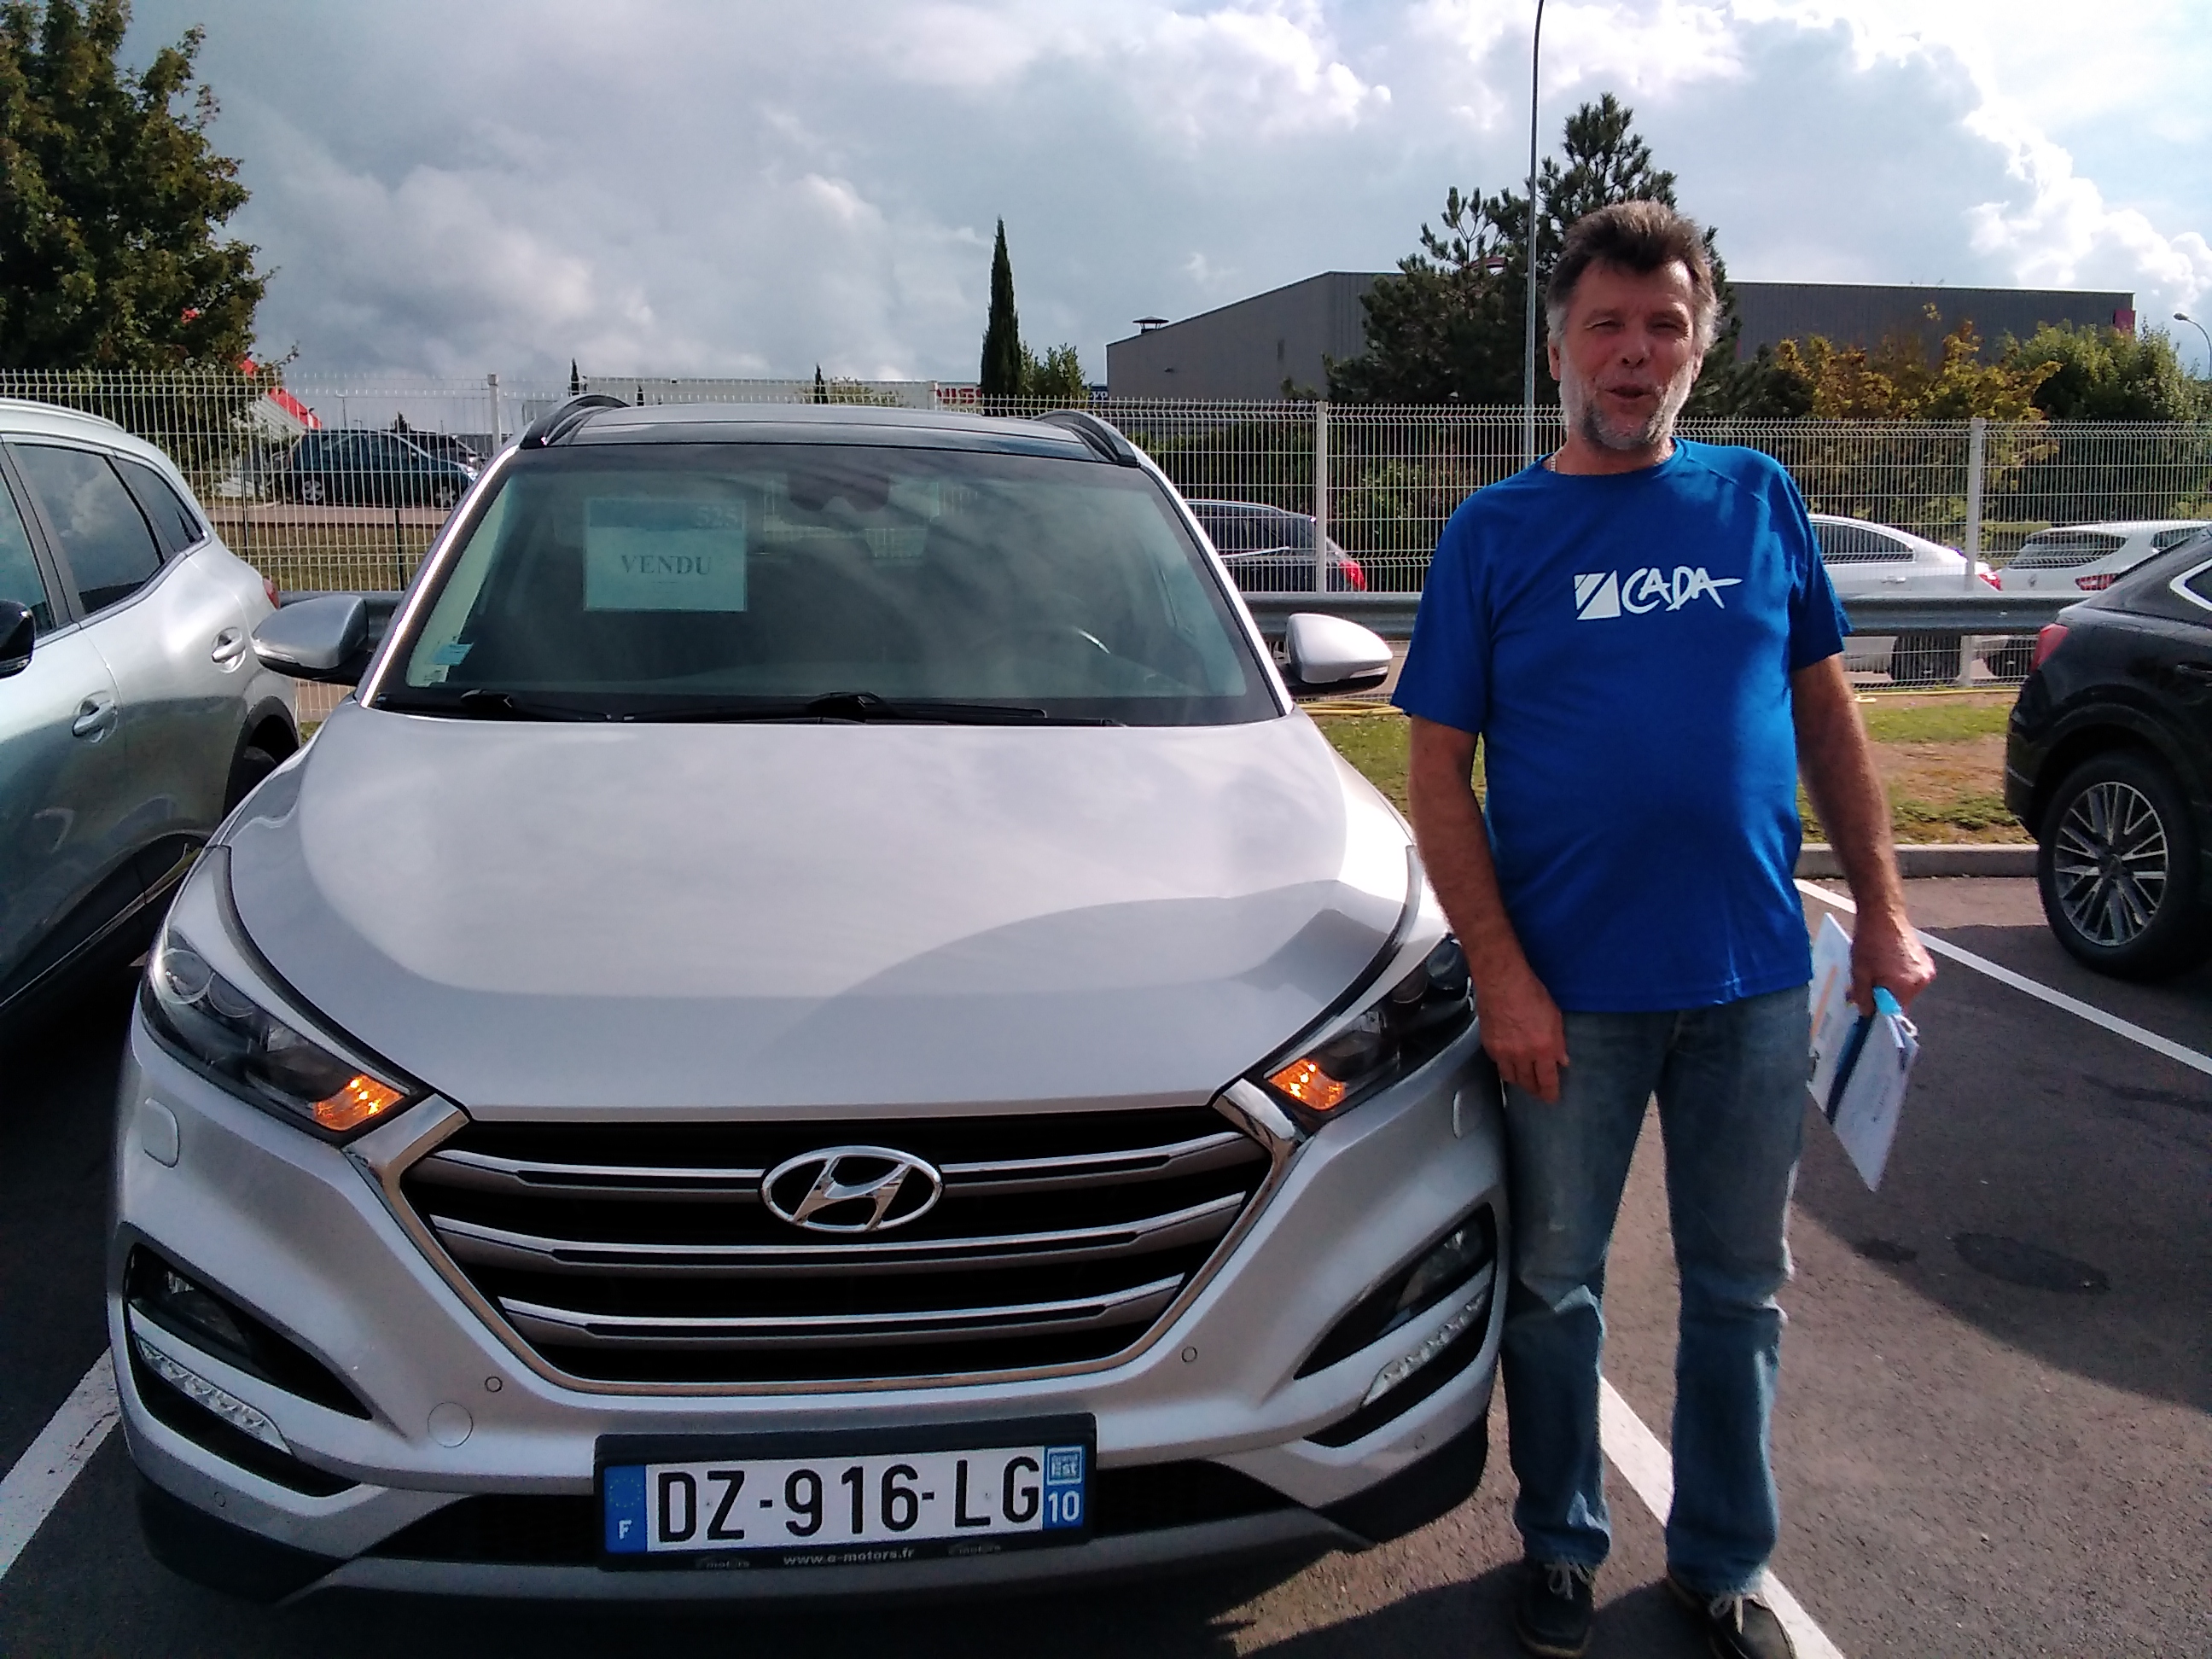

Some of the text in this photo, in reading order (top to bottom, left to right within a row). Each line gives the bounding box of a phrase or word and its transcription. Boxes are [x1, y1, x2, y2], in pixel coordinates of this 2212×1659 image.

[621, 555, 711, 575] VENDU
[1622, 566, 1743, 614] CADA
[657, 1456, 1040, 1543] DZ-916-LG
[1048, 1490, 1080, 1523] 10
[619, 1520, 632, 1540] F
